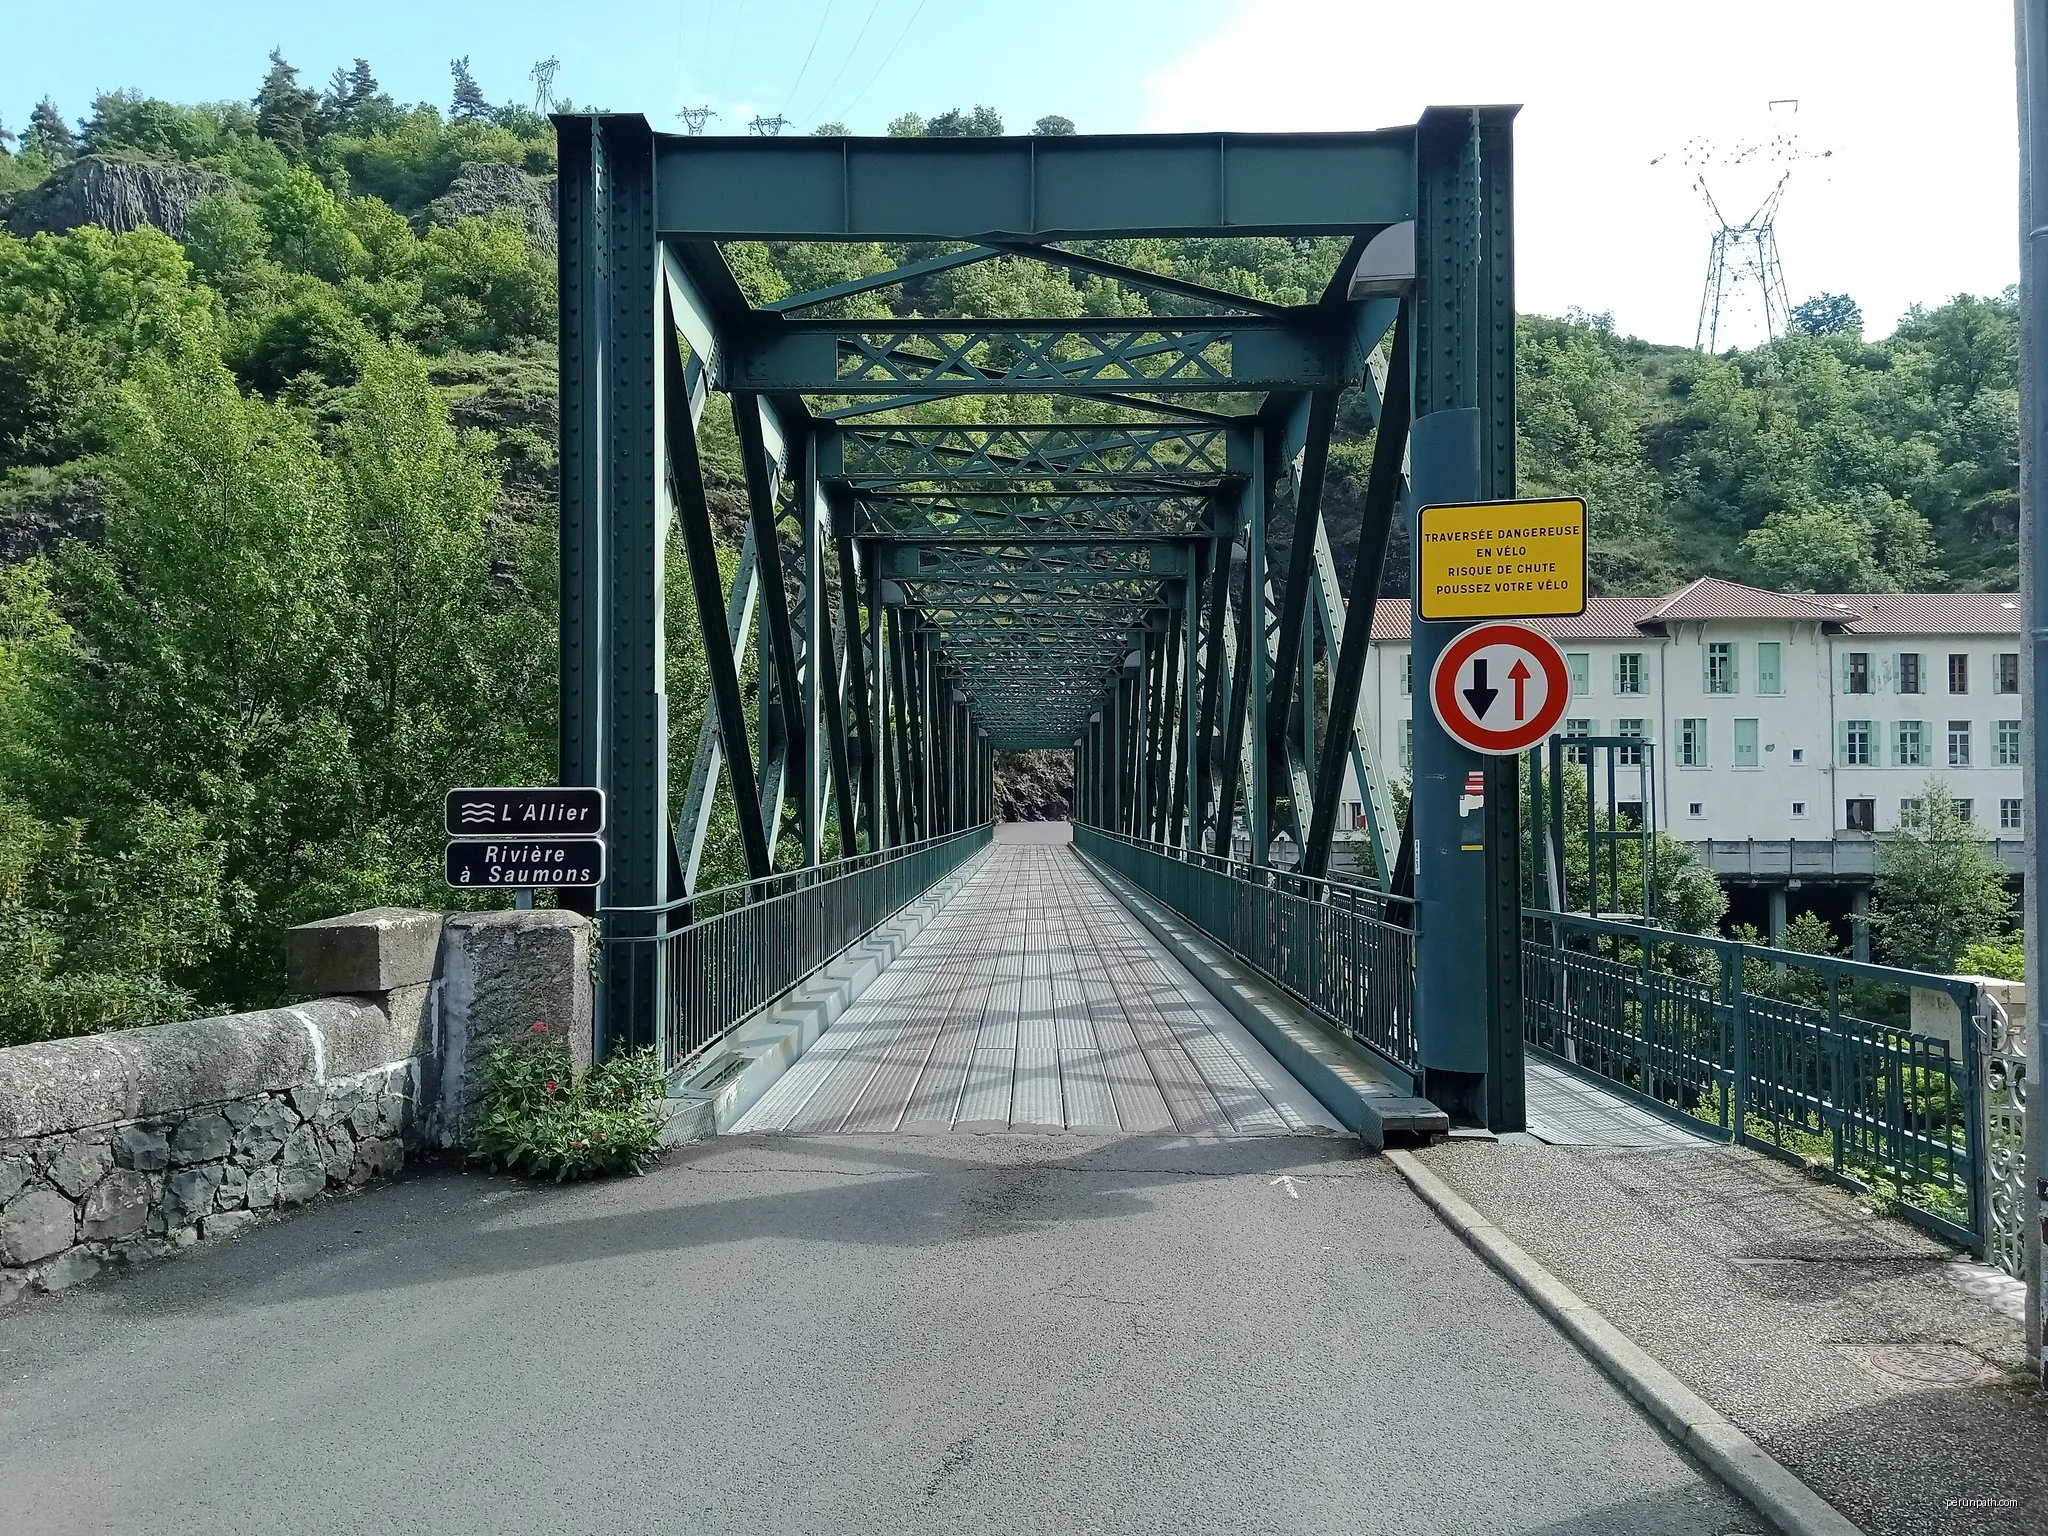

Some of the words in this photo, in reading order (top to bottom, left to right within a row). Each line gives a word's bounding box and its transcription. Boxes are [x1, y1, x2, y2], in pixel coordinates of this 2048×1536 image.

[1425, 529, 1493, 542] TRAVERSÉE
[1498, 525, 1580, 539] DANGEREUSE
[1477, 548, 1492, 557] EN
[1497, 545, 1526, 557] VÉLO
[1448, 566, 1492, 577] RISQUE
[1498, 565, 1513, 574] DE
[1517, 563, 1556, 573] CHUTE
[1437, 584, 1490, 594] POUSSEZ
[1495, 582, 1532, 592] VOTRE
[1538, 579, 1569, 590] VÉLO
[485, 846, 565, 862] Rivière
[460, 866, 471, 882] à
[489, 866, 590, 882] Saumons
